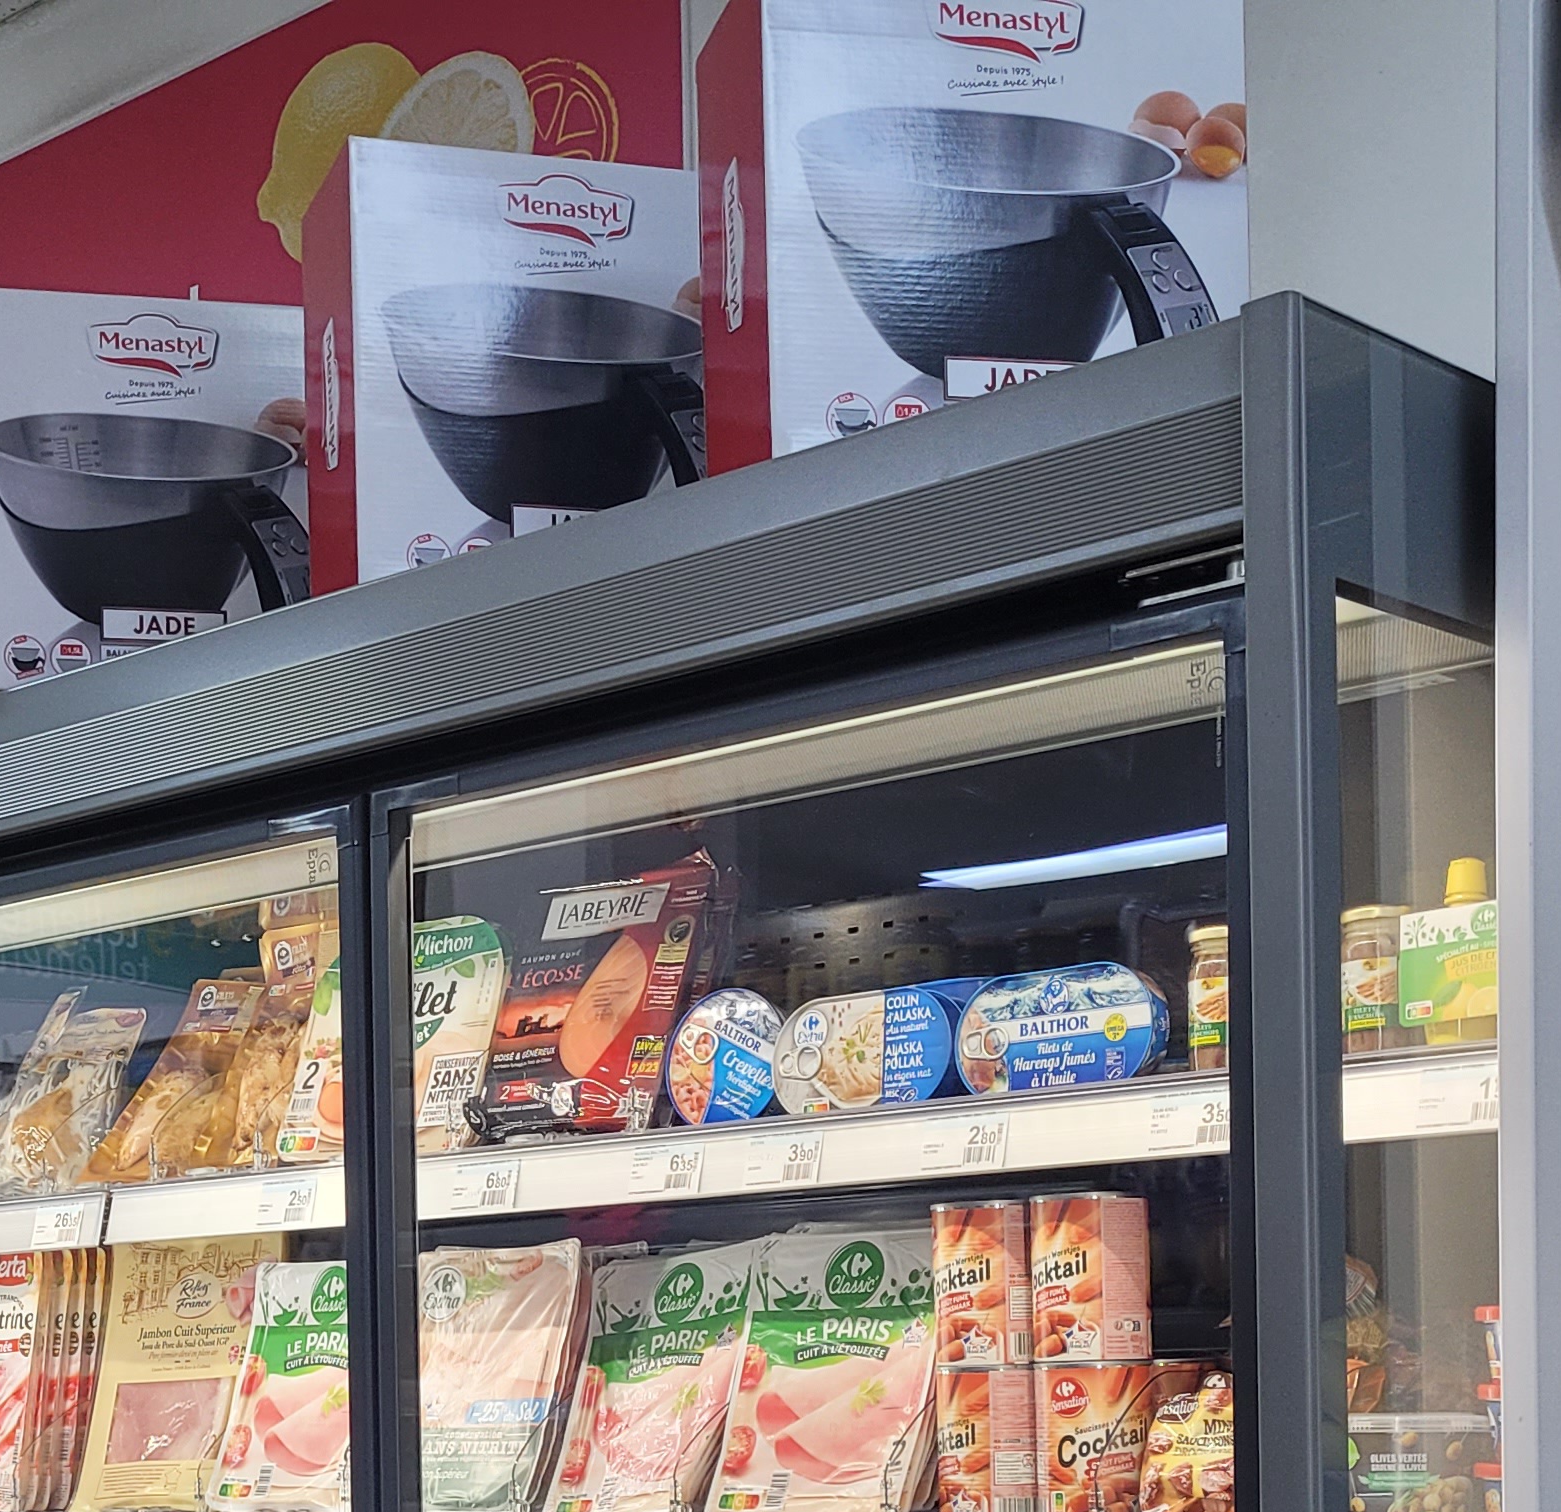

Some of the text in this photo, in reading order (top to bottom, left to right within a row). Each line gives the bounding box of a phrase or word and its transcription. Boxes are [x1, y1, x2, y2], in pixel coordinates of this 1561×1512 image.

[939, 4, 1069, 38] Menastyl
[976, 64, 1008, 77] Depuis
[947, 75, 1058, 90] Cuisinez avec style
[507, 192, 622, 226] Menastyl
[539, 247, 568, 258] Depuis
[562, 260, 586, 268] avec
[587, 258, 611, 270] style
[98, 331, 207, 362] Menastyl
[129, 379, 155, 388] Depuis
[133, 614, 196, 636] JADE
[558, 892, 651, 930] LABEYRIE
[415, 934, 474, 957] Michon
[886, 994, 920, 1010] COLIN
[1019, 1013, 1090, 1038] BALTHOR
[713, 1019, 763, 1054] BALTHOR
[1036, 1040, 1061, 1055] Filets
[1013, 1050, 1097, 1074] Harengs fumés
[301, 1060, 321, 1092] 2
[431, 1068, 478, 1089] SANS
[1041, 1070, 1078, 1087] l'huile
[175, 1298, 212, 1314] France
[137, 1323, 237, 1343] Jambon Cuit Supérieur
[650, 1329, 709, 1353] PARIS
[796, 1317, 893, 1344] LE PARIS
[287, 1339, 302, 1356] LE
[797, 1347, 824, 1361] CUIT
[285, 1358, 303, 1371] CUIT
[1057, 1418, 1148, 1468] Cocktail
